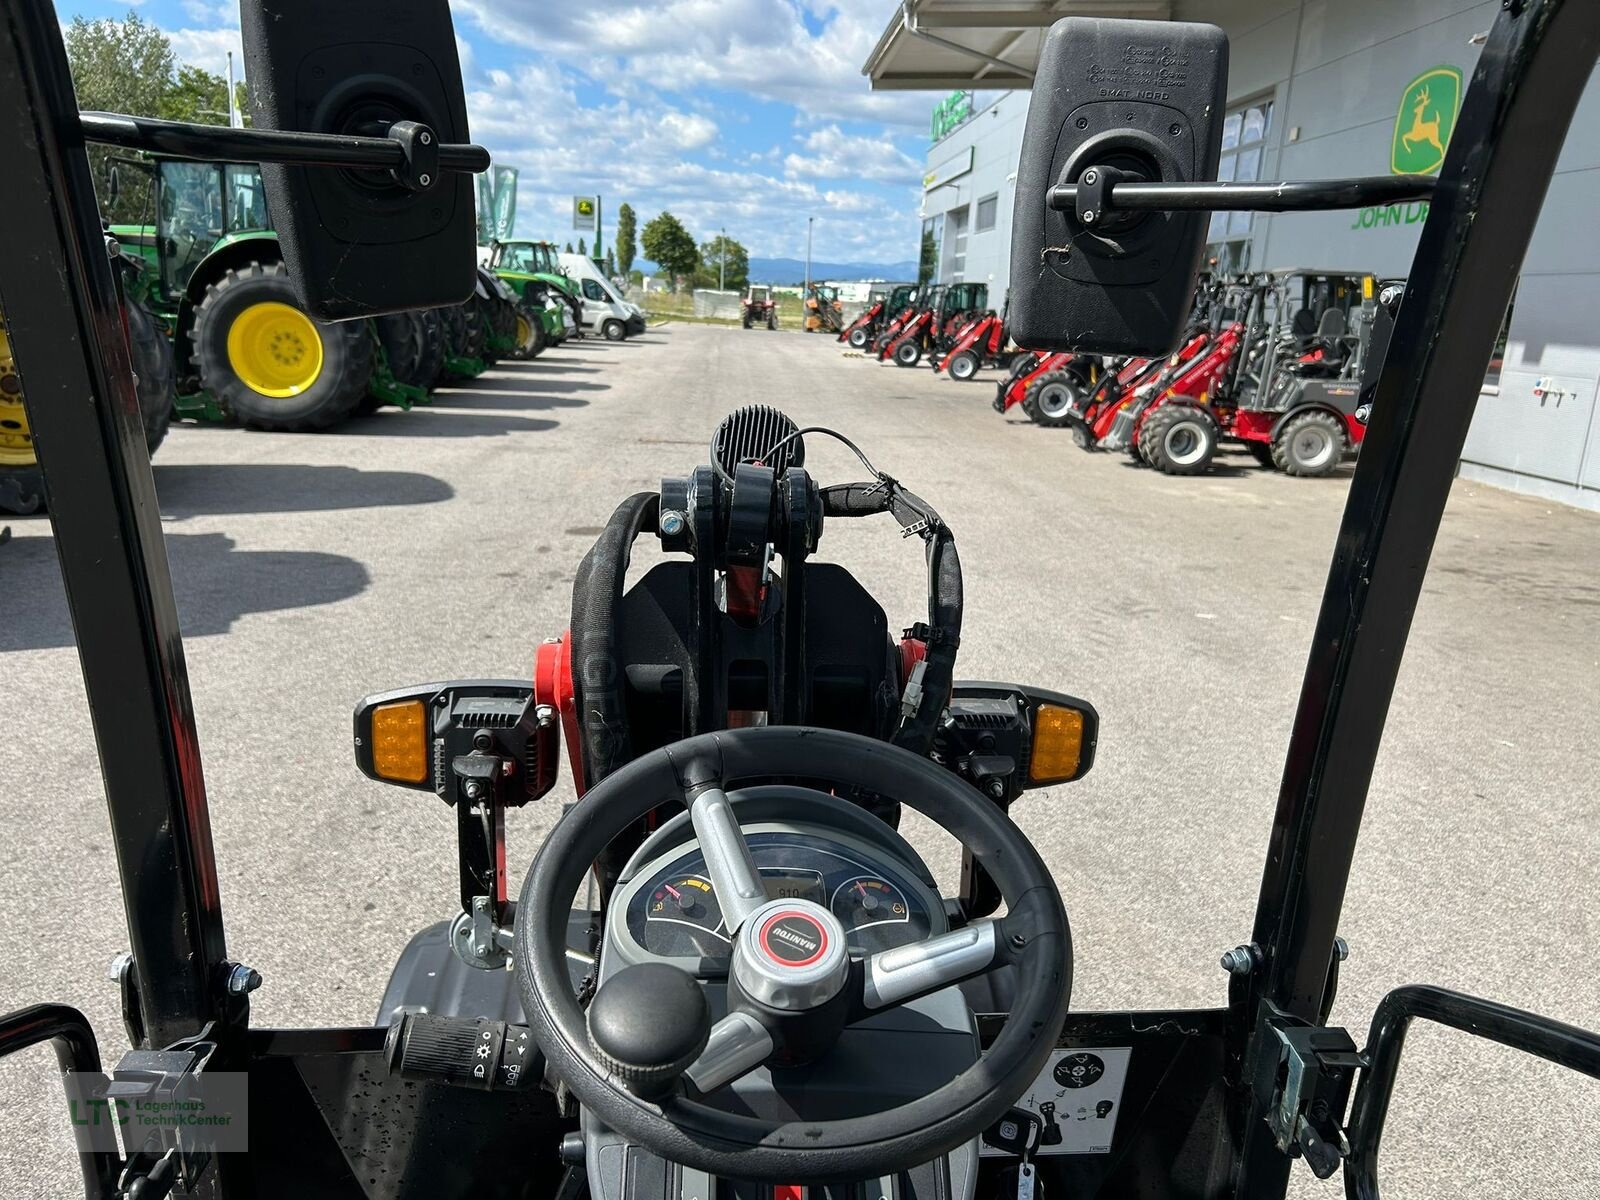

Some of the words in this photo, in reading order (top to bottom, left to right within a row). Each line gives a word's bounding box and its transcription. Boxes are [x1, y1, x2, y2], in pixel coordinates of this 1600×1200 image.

[1099, 88, 1130, 98] SMAT
[1137, 90, 1170, 100] NORD
[1351, 206, 1402, 230] JOHN
[779, 888, 799, 898] 910
[772, 927, 816, 951] MANITOU
